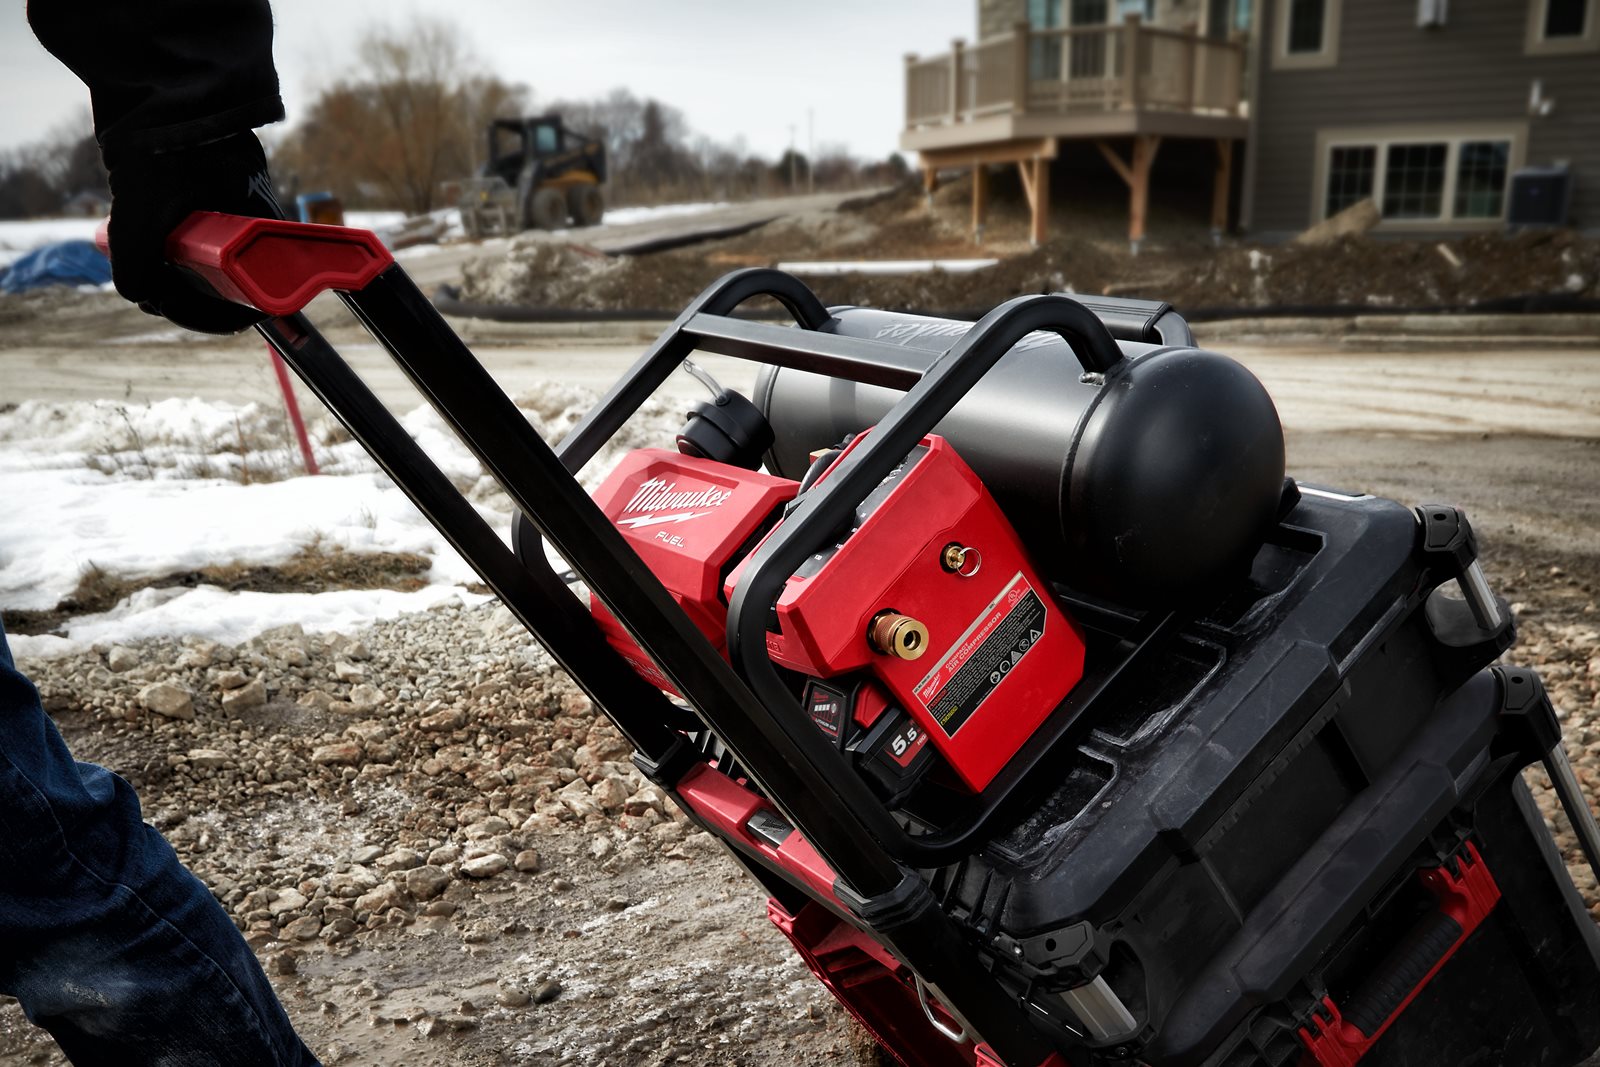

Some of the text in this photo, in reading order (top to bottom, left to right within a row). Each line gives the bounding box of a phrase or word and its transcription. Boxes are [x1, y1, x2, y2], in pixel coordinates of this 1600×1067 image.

[623, 477, 732, 513] Milwaukee
[655, 531, 685, 547] FUEL
[945, 642, 969, 669] COMPACT
[948, 660, 959, 673] AIR
[960, 612, 1002, 660] COMPRESSOR
[891, 727, 918, 756] 5.5
